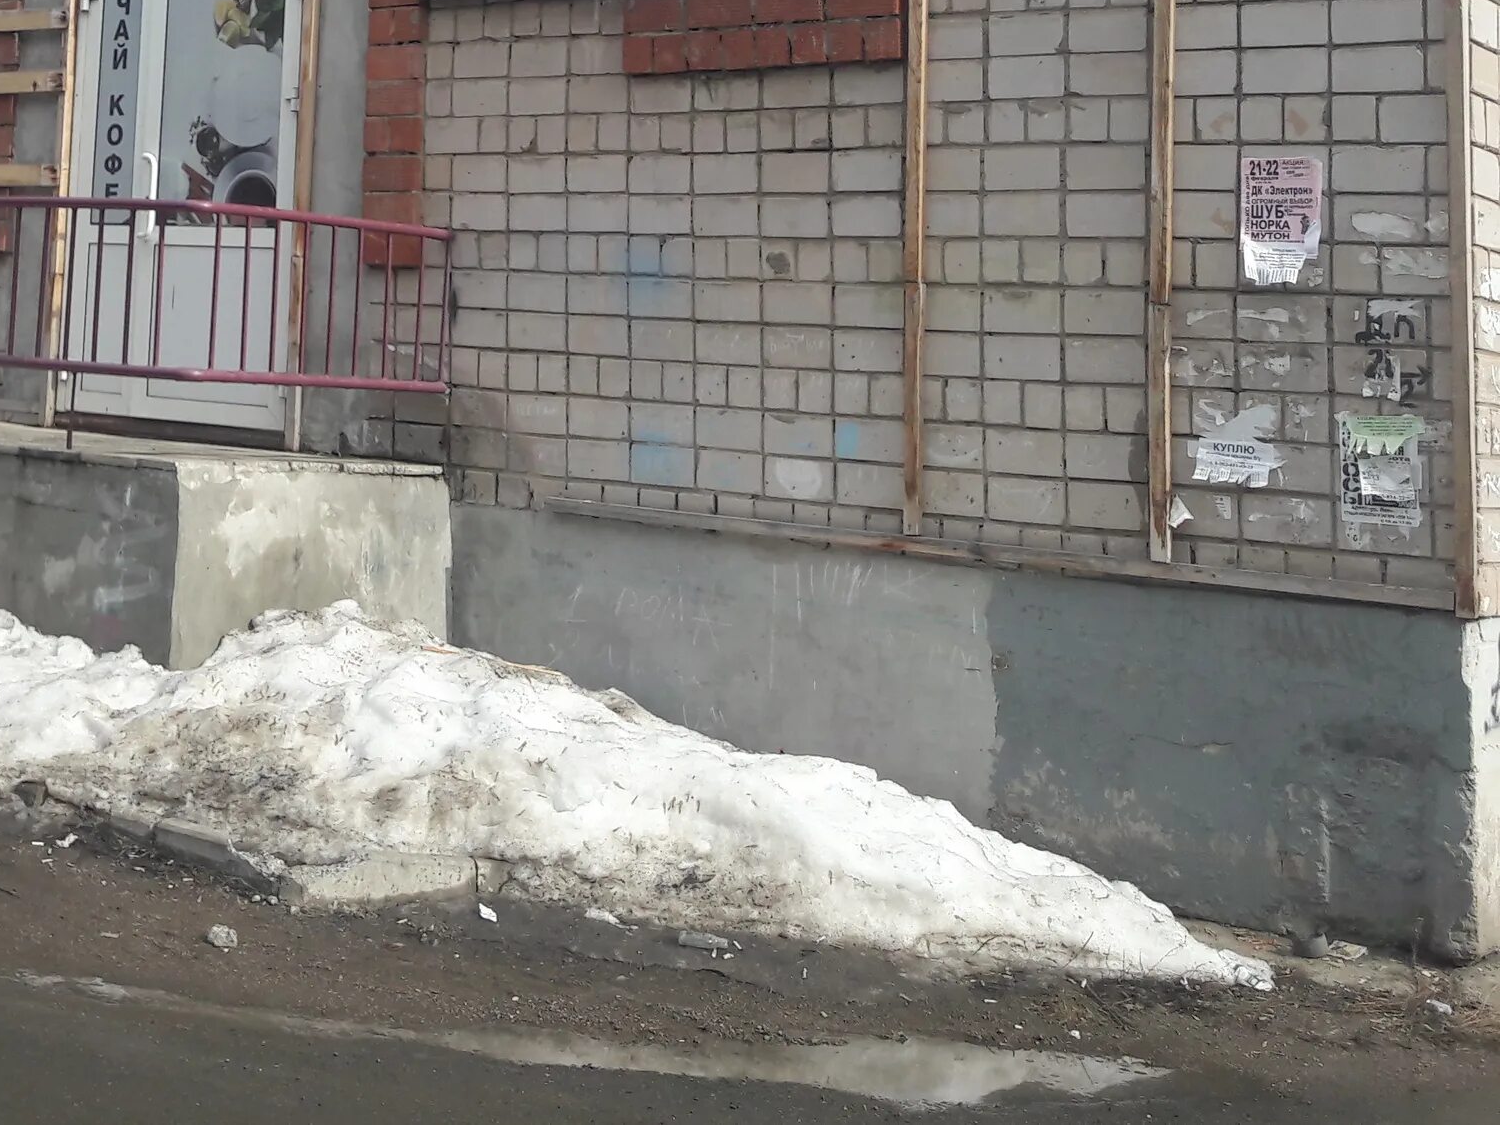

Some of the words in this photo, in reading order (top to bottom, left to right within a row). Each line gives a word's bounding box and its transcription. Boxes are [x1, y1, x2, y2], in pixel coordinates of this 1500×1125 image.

[1251, 186, 1263, 197] ДК
[1265, 186, 1313, 197] «Электрон»
[1251, 205, 1285, 219] ШУБ
[1251, 220, 1291, 230] НОРКА
[1251, 232, 1290, 240] МУТОН
[1213, 443, 1255, 455] КУПЛЮ
